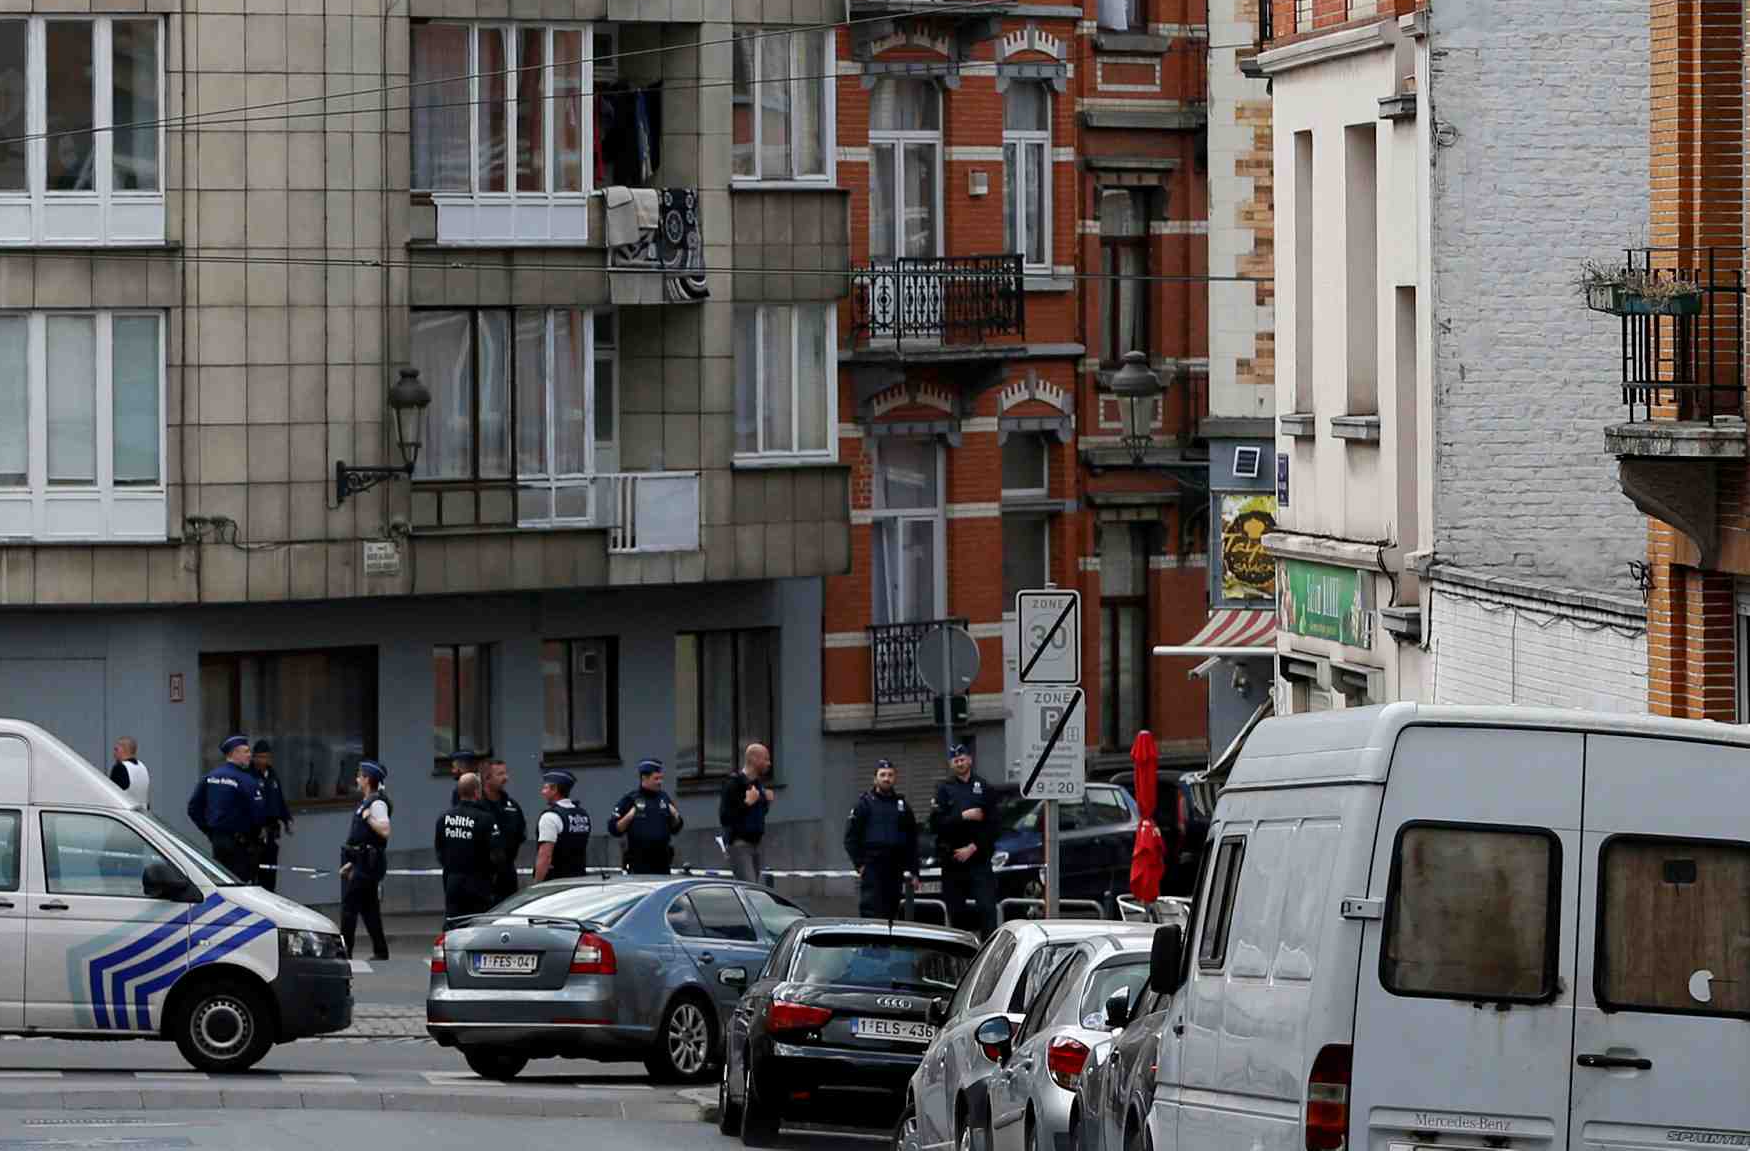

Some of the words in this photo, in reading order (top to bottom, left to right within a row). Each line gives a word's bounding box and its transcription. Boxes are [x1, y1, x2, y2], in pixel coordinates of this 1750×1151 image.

[1032, 599, 1065, 608] ZONE
[1030, 625, 1067, 649] 30
[1033, 693, 1071, 704] ZONE
[1036, 782, 1045, 793] 9
[1058, 782, 1074, 793] 20
[444, 815, 475, 828] Politie
[445, 827, 473, 840] Police
[1414, 1112, 1511, 1132] Mercedes-Benz
